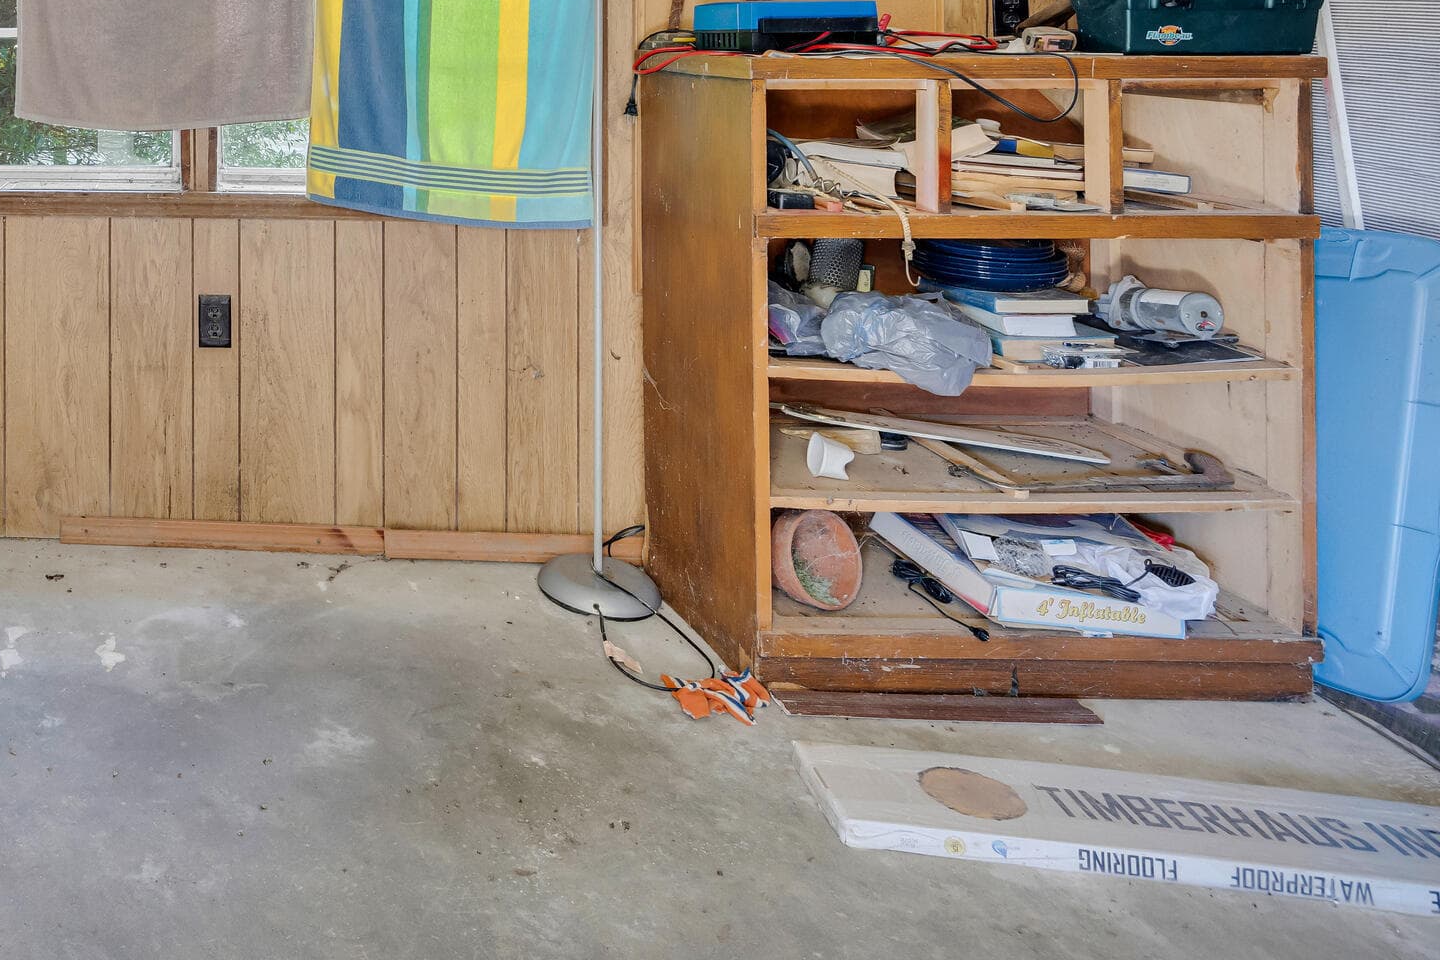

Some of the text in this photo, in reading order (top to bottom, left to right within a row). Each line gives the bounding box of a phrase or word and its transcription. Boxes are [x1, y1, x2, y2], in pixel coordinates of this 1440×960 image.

[1056, 598, 1147, 625] Inflatable
[1032, 783, 1378, 853] TIMBERHAUS
[1077, 847, 1375, 907] WATERPROOF FLOORING
